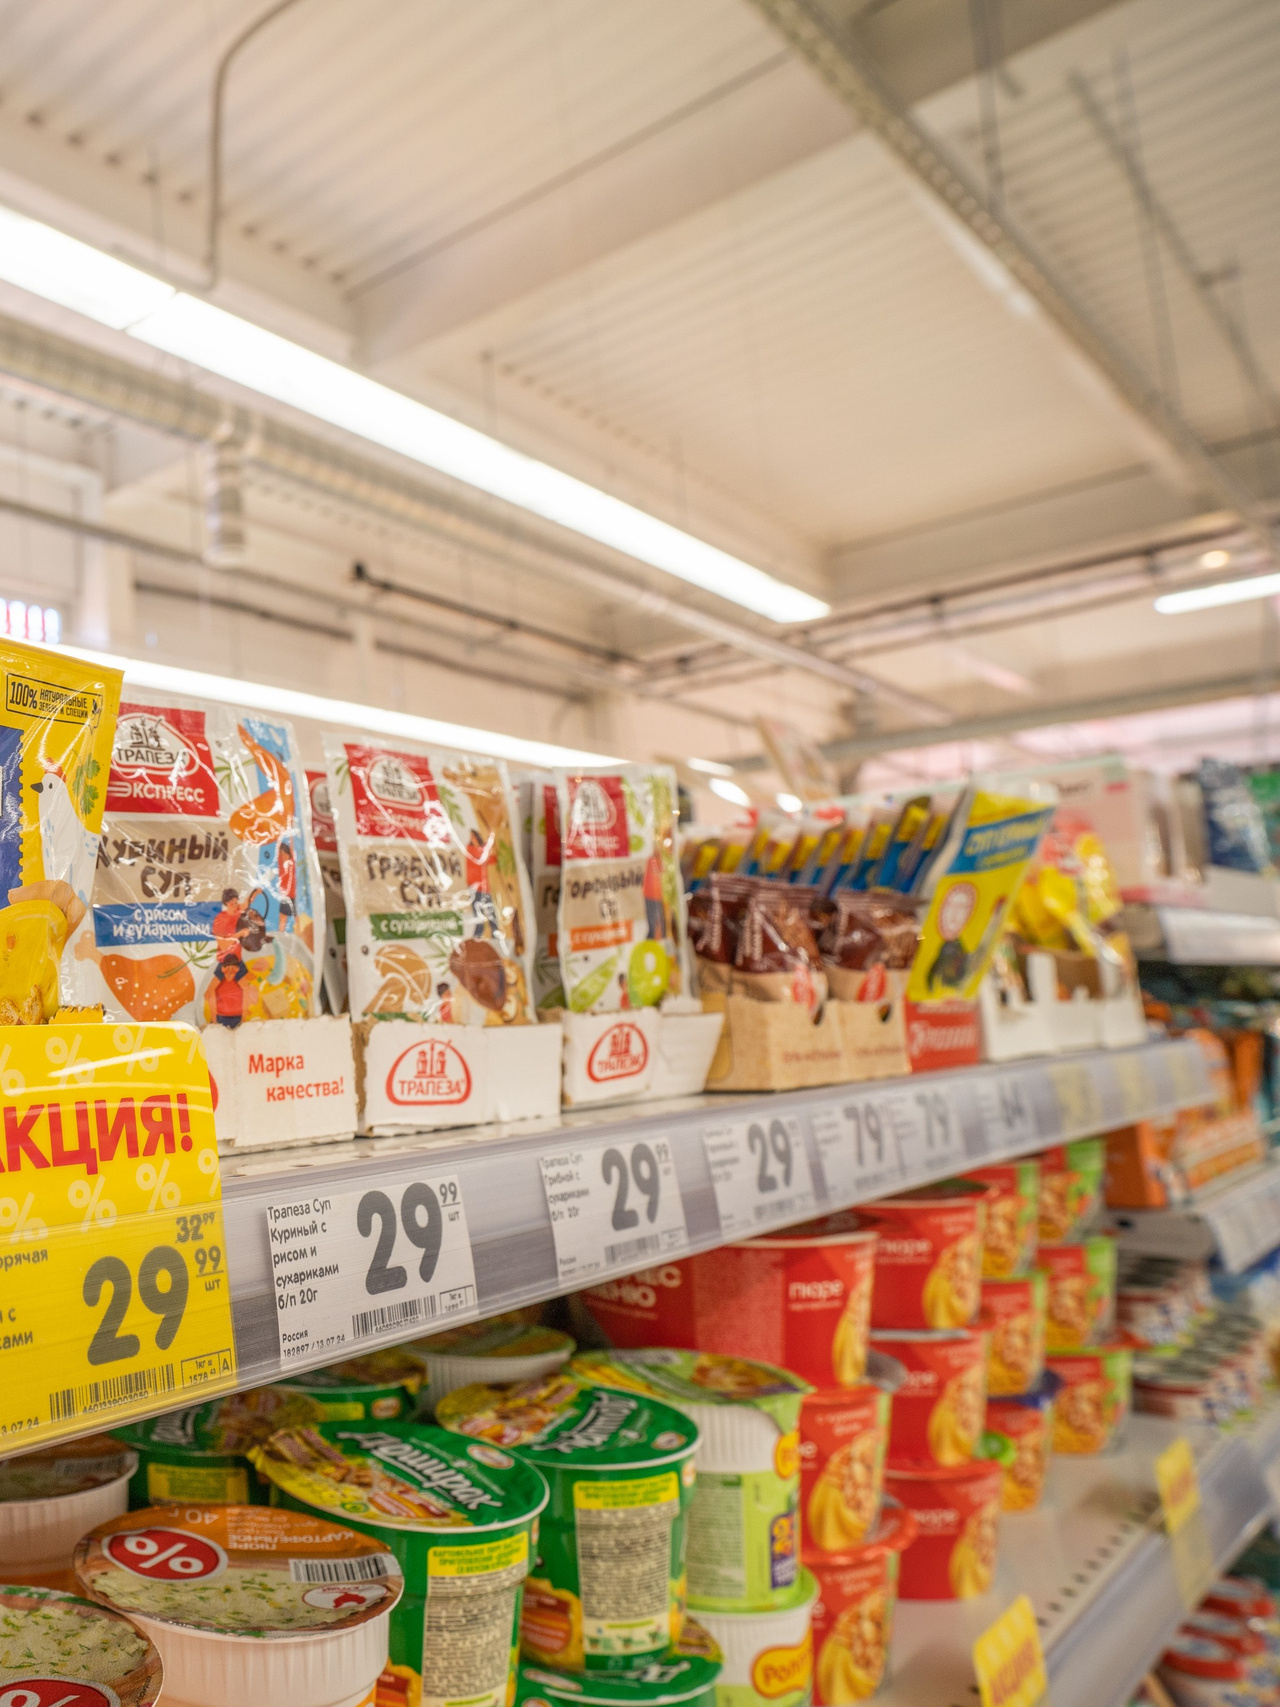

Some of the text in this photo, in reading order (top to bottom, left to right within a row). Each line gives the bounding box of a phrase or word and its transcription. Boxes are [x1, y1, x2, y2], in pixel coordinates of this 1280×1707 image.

[10, 681, 38, 709] 100%
[107, 781, 205, 803] ЭКСПРЕСС
[248, 1053, 304, 1078] Марка
[267, 1076, 345, 1102] качества!
[398, 1079, 465, 1098] ТРАПЕЗА
[747, 1119, 793, 1194] 29
[601, 1143, 660, 1232] 29
[267, 1198, 331, 1223] Трапеза Суп
[448, 1210, 460, 1222] шт
[176, 1214, 203, 1243] 32
[270, 1220, 327, 1244] Куриный с
[357, 1182, 458, 1295] 29 99
[273, 1245, 317, 1268] рисом и
[205, 1279, 221, 1292] шт
[276, 1263, 340, 1289] сухариками
[82, 1245, 221, 1367] 29 99
[278, 1287, 318, 1310] б/п 20г
[8, 1308, 16, 1323] с
[282, 1329, 309, 1344] Россия
[283, 1343, 309, 1358] 182897
[316, 1334, 346, 1350] 13.07.24
